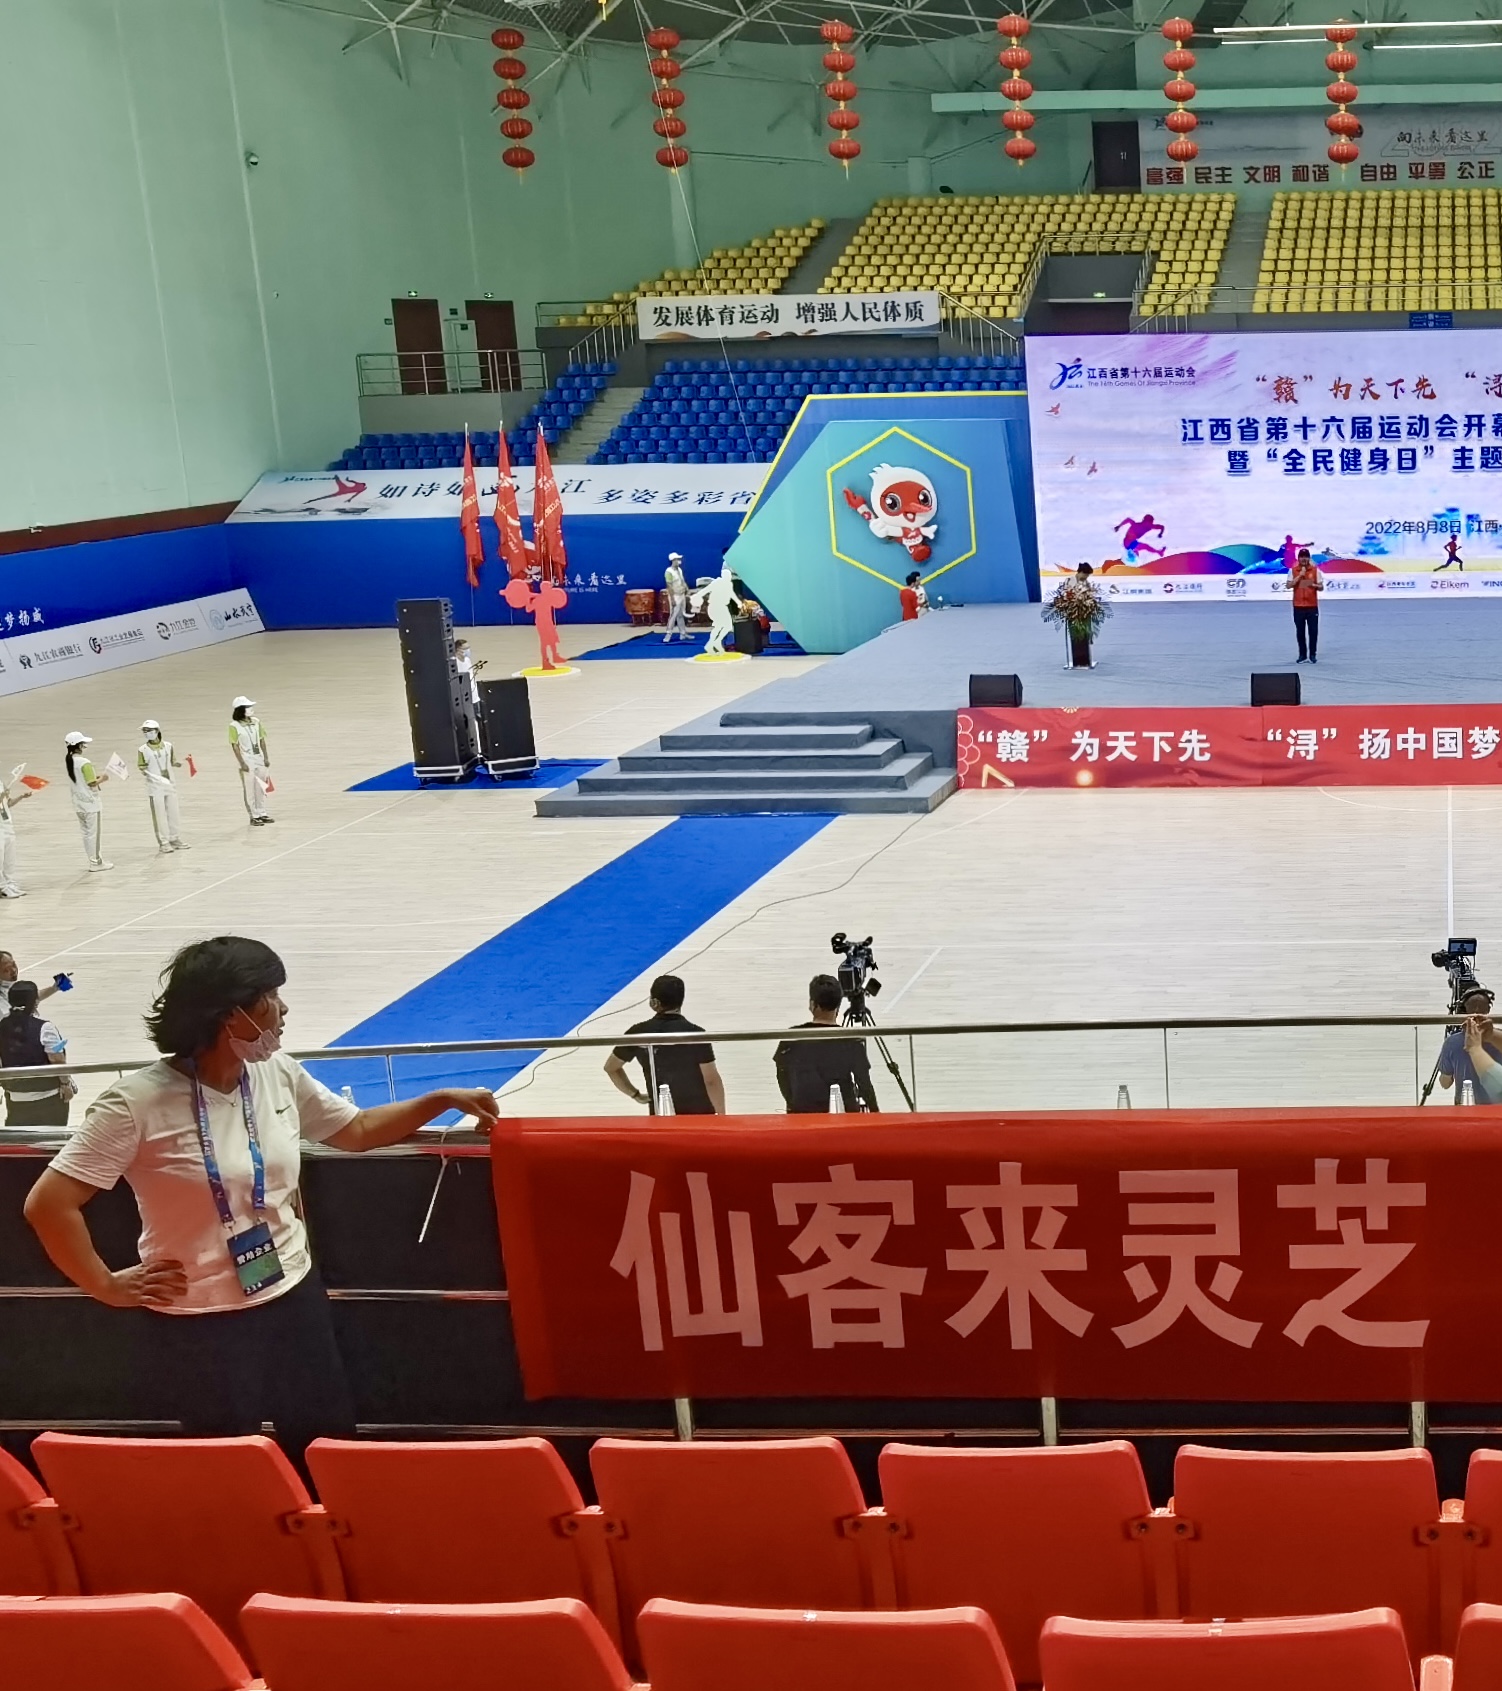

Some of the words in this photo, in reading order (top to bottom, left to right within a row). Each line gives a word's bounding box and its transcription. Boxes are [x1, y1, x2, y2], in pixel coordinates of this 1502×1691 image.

[1146, 167, 1185, 185] 富强
[1194, 166, 1233, 184] 民主
[1243, 165, 1281, 183] 文明
[1292, 164, 1330, 183] 和谐
[1360, 163, 1397, 182] 自由
[1456, 160, 1495, 180] 公正
[652, 302, 780, 328] 发展体育运动
[795, 300, 925, 324] 增强人民体质
[1087, 365, 1196, 379] 江西省第十六届运动会
[1366, 519, 1462, 535] 2022年8月8日
[1440, 581, 1469, 589] Elkem
[608, 1160, 1434, 1355] 仙客来灵芝
